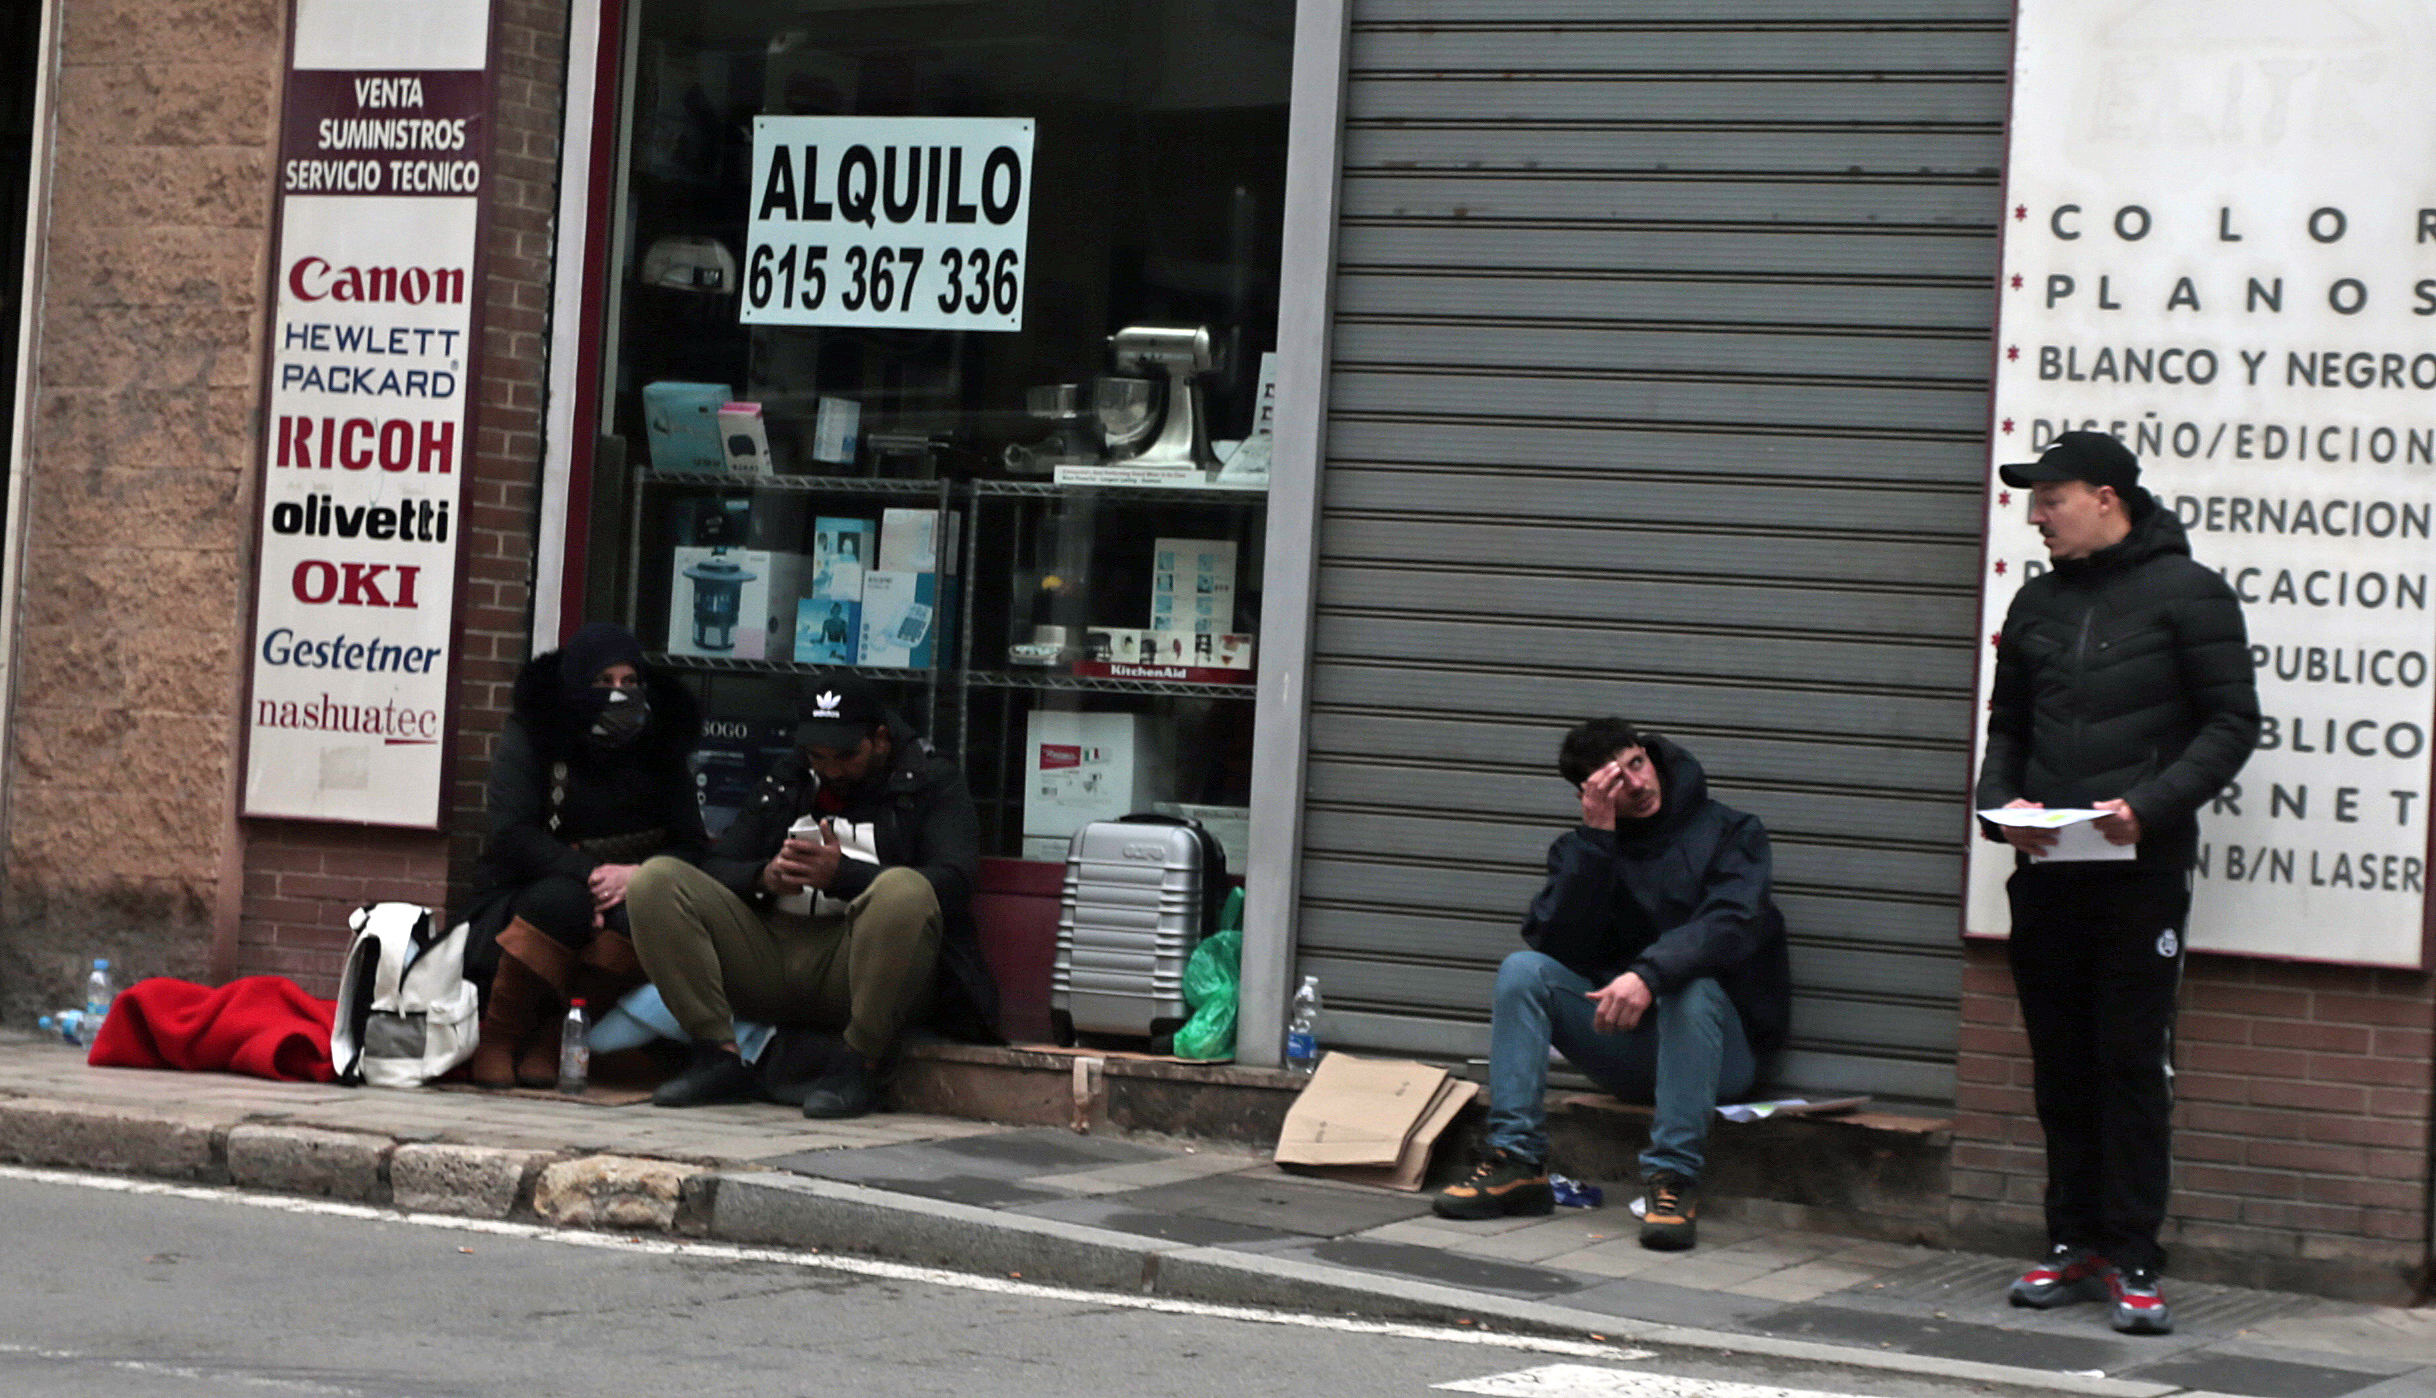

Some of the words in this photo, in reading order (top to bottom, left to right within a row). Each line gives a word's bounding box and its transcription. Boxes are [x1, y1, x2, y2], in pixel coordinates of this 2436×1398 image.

[354, 77, 424, 108] VENTA
[318, 118, 466, 151] SUMINISTROS
[285, 159, 382, 191] SERVICIO
[389, 160, 480, 192] TECNICO
[758, 144, 1022, 230] ALQUILO
[288, 256, 465, 306] Canon
[748, 243, 828, 310] 615
[841, 245, 924, 312] 367
[937, 247, 1019, 316] 336
[2046, 274, 2436, 317] PLANOS
[285, 322, 460, 357] HEWLETT
[281, 363, 456, 399] PACKARD
[2038, 345, 2218, 386] BLANCO
[2240, 350, 2267, 386] Y
[2286, 351, 2436, 391] NEGRO
[276, 415, 455, 474] RICOH
[271, 493, 449, 543] olivetti
[2152, 494, 2431, 539] DERNACION
[291, 559, 421, 609] OKI
[262, 628, 442, 674] Gestetner
[2251, 643, 2427, 688] PUBLICO
[256, 693, 437, 740] nashuatec
[2256, 716, 2424, 759] BLICO
[2212, 781, 2418, 826] RNET
[2225, 844, 2295, 884] B/N
[2310, 850, 2423, 894] LASER
